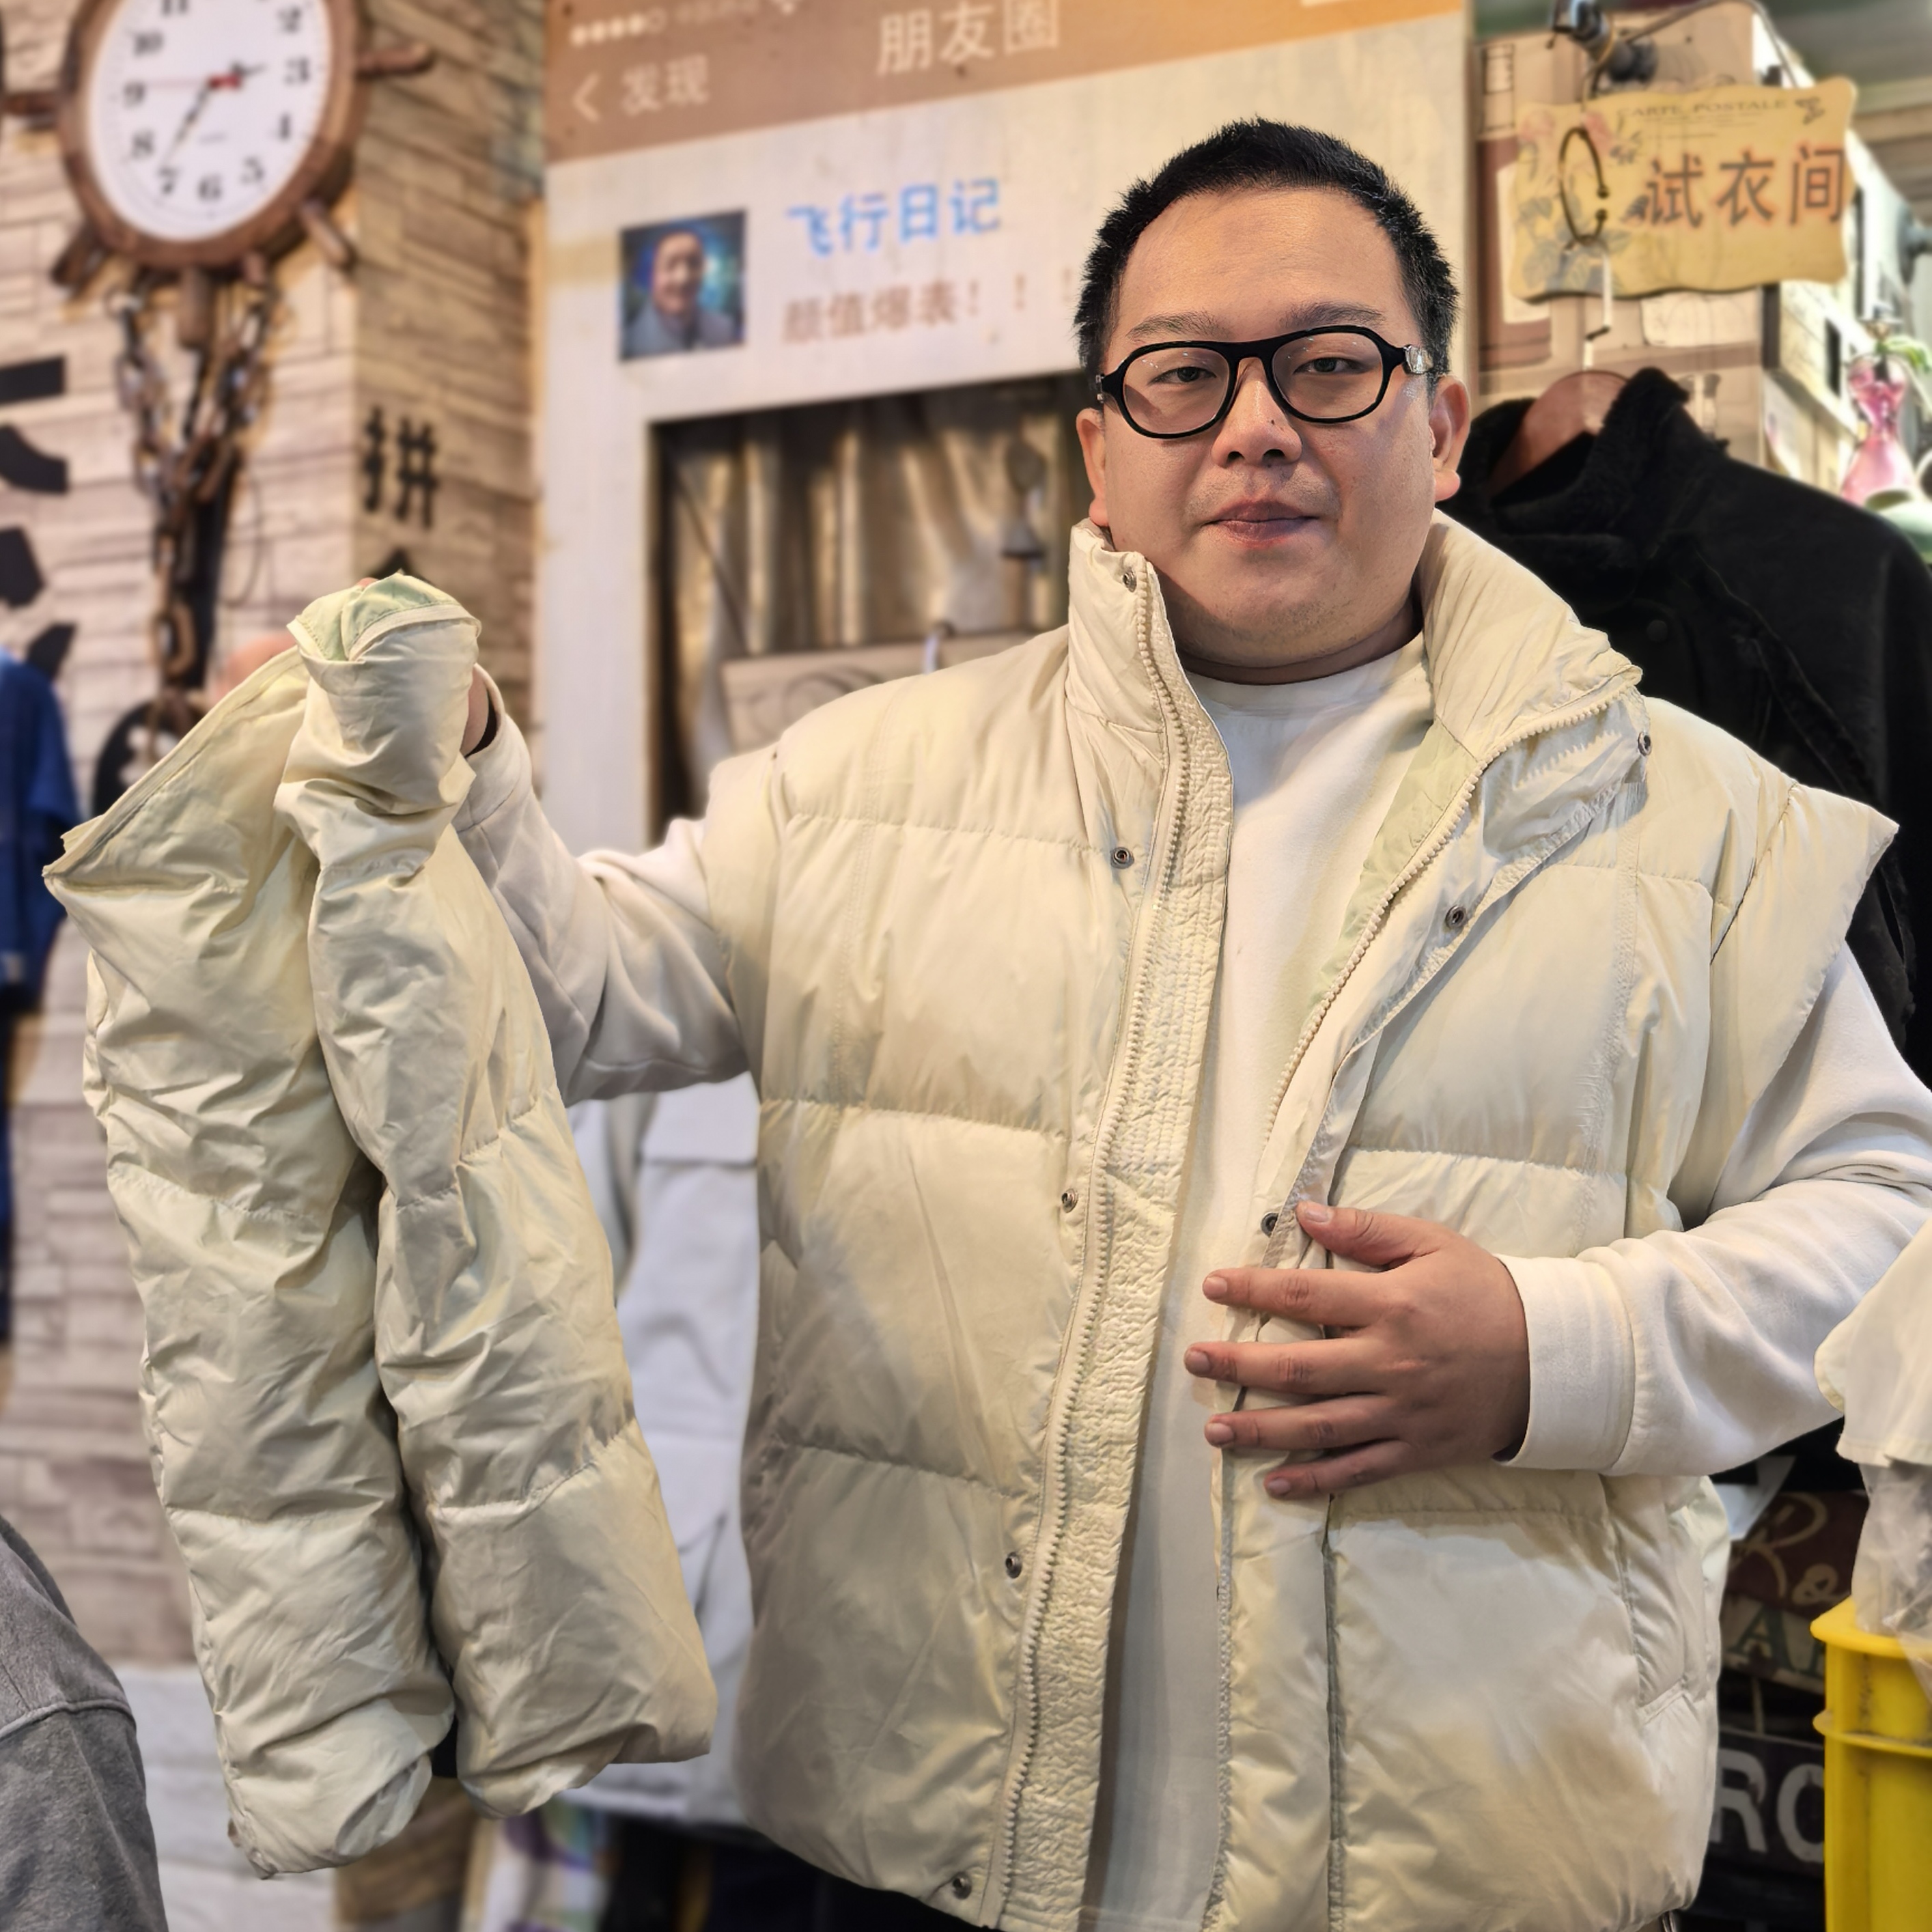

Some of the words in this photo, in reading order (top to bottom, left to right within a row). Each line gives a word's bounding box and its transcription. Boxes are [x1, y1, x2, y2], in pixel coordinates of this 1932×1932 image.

[278, 8, 300, 33] 2
[132, 31, 164, 56] 10
[876, 0, 1059, 76] 朋友圈
[285, 57, 309, 84] 3
[123, 82, 145, 107] 9
[621, 54, 708, 116] 发现
[132, 130, 154, 159] 8
[157, 167, 180, 195] 7
[241, 156, 264, 184] 5
[199, 173, 222, 201] 6
[1646, 145, 1844, 229] 试衣间
[785, 178, 1000, 256] 飞行日记
